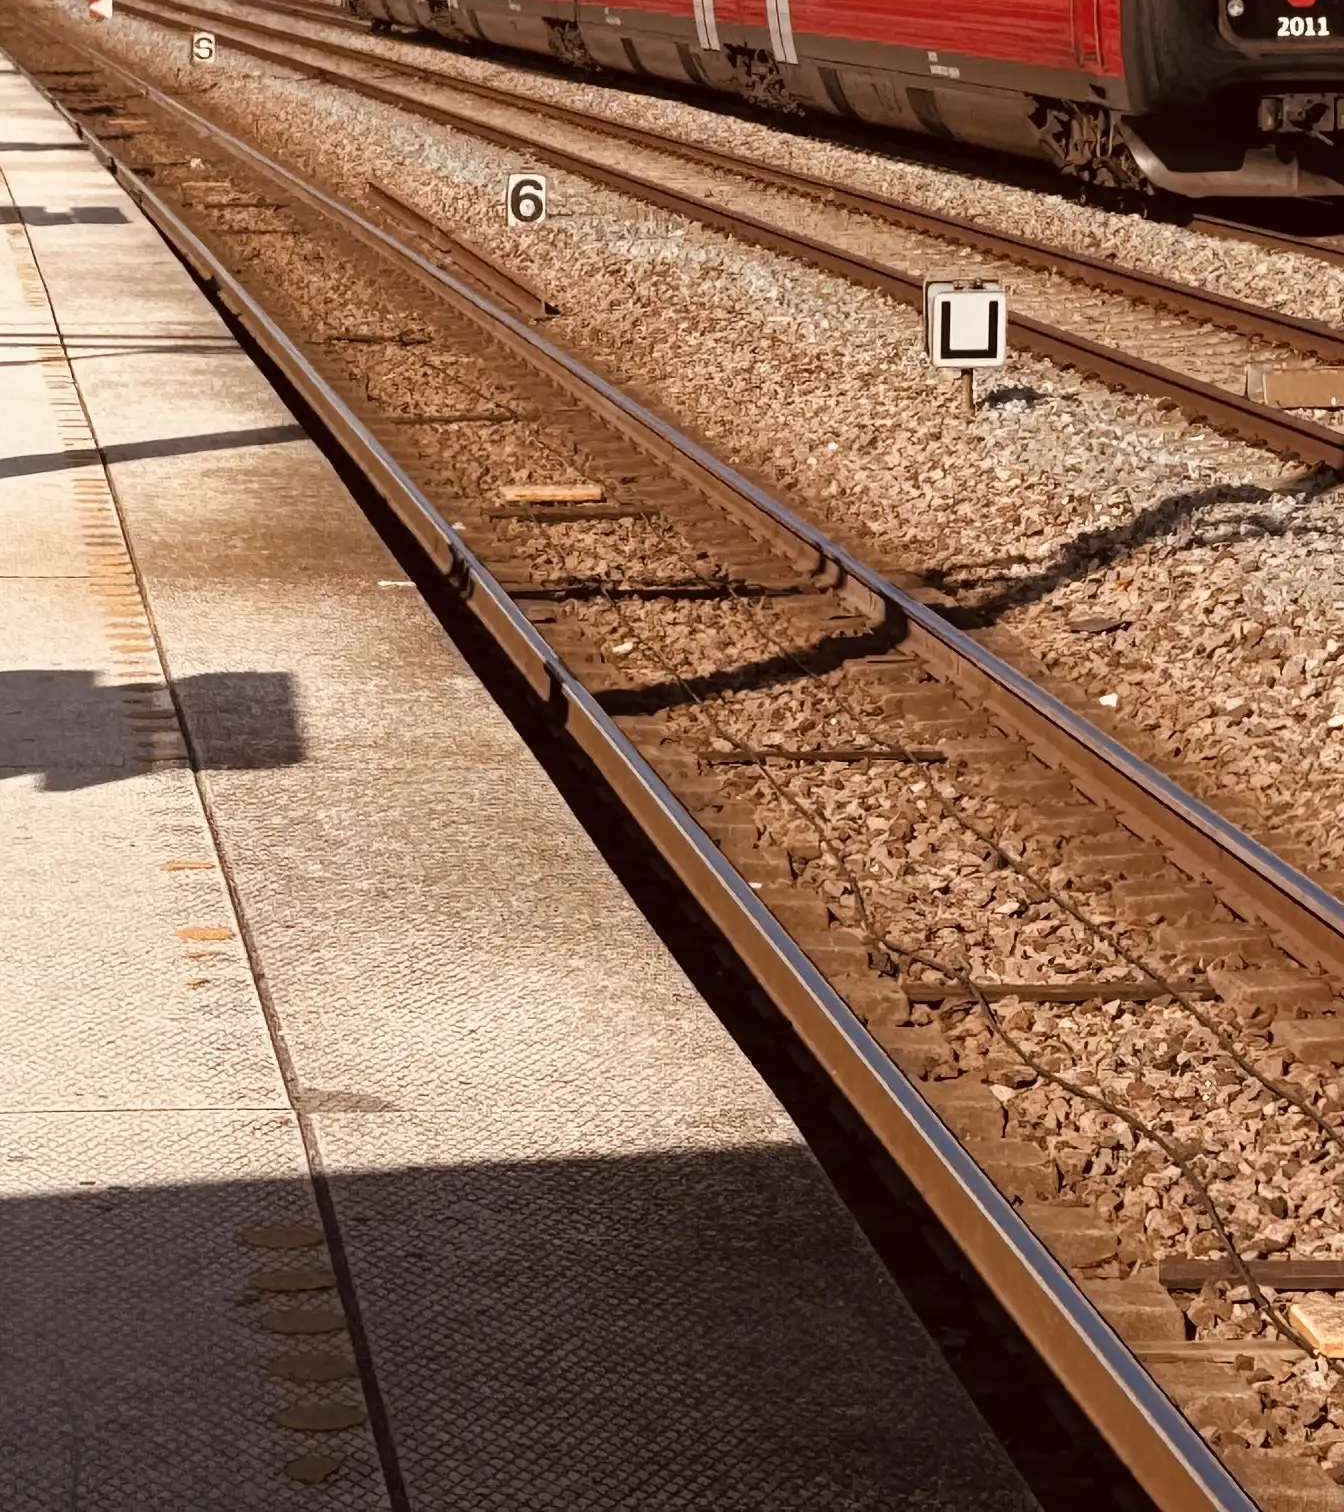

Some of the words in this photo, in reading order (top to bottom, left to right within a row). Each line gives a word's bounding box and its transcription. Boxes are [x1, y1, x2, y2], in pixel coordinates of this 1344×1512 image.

[1276, 16, 1331, 37] 2011
[194, 37, 214, 60] S
[510, 179, 544, 223] 6
